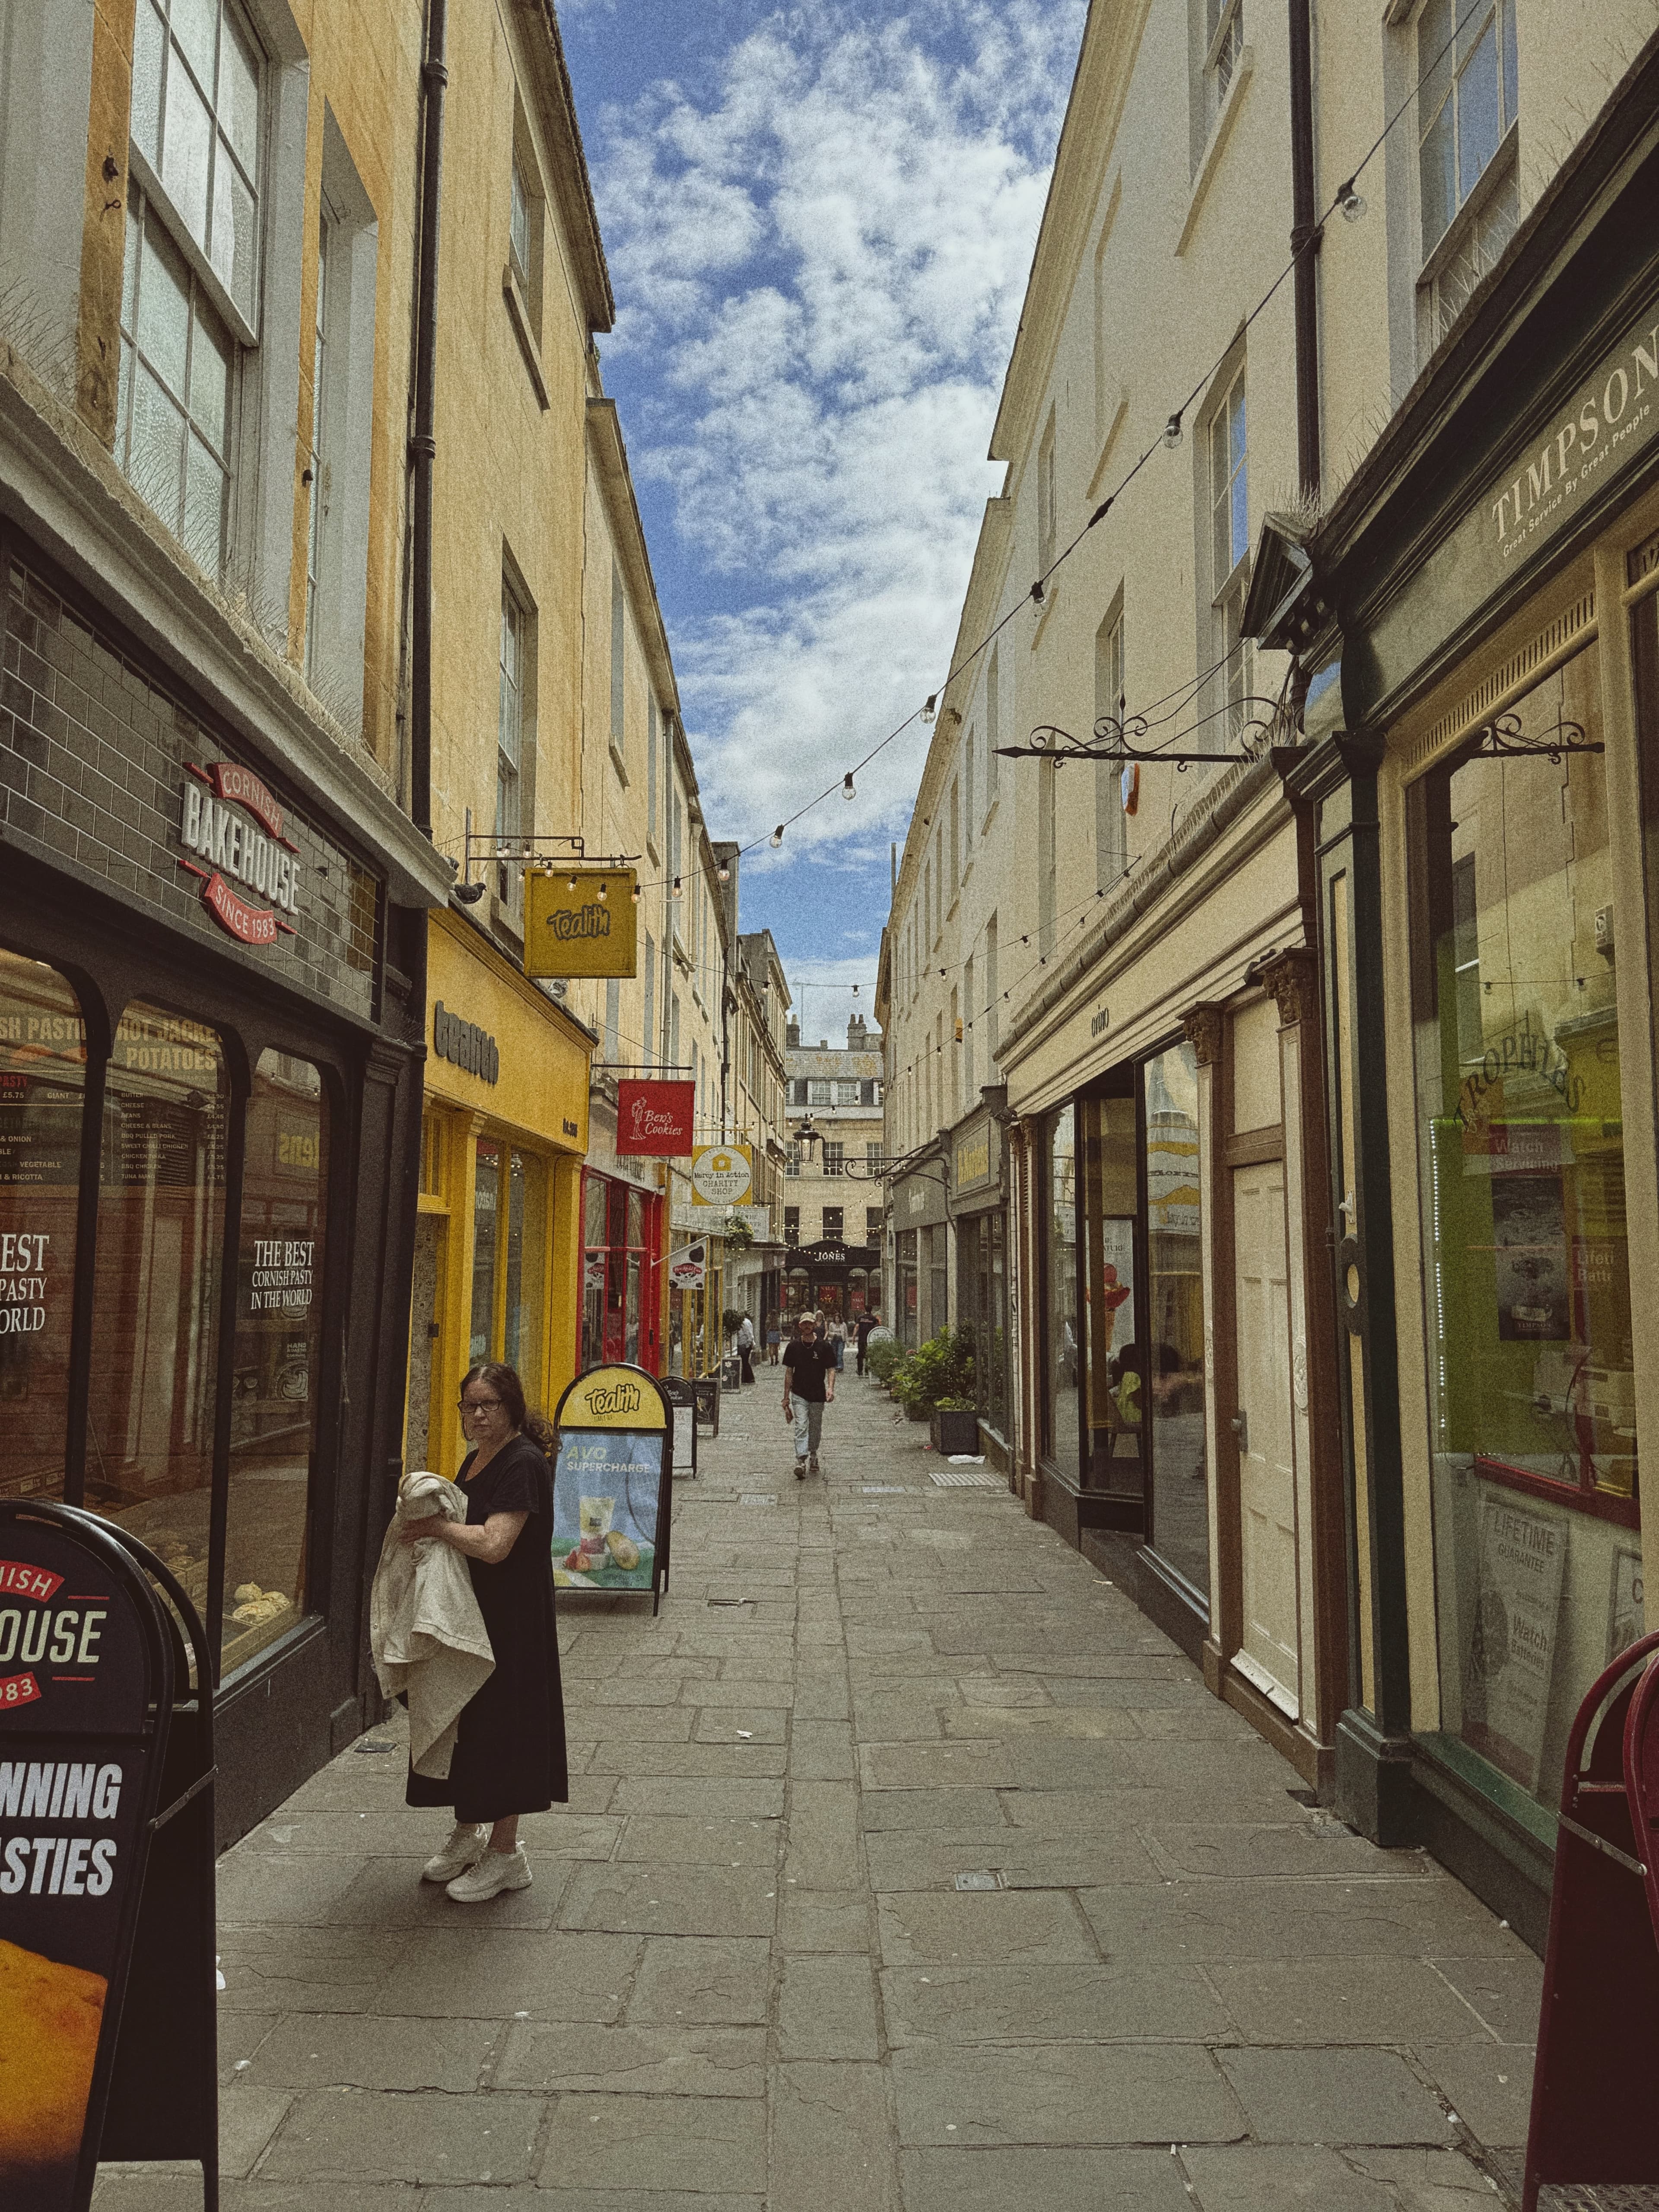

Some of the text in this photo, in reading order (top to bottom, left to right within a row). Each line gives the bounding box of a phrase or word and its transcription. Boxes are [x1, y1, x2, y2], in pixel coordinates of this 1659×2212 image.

[1492, 324, 1659, 543] TIMPSON
[1503, 404, 1649, 558] Great Service By Great People
[222, 770, 280, 830] CORNISH
[181, 782, 300, 916] BAKEHOUSE
[216, 885, 274, 939] SINCE 1983
[1091, 1004, 1109, 1038] orino
[127, 1047, 216, 1070] POTATOES
[644, 1110, 673, 1123] Ben's
[645, 1122, 683, 1135] Cookies
[0, 1234, 49, 1272] EST
[254, 1240, 315, 1267] THE BEST
[814, 1252, 845, 1262] JONES
[252, 1269, 313, 1287] CORNISH PASTY
[251, 1289, 312, 1309] IN THE WORLD
[566, 1446, 607, 1460] AVO
[566, 1462, 650, 1473] SUPERCHARGE
[1494, 1511, 1555, 1557] LIFETIME
[1498, 1543, 1545, 1574] GUARANTEE
[0, 1609, 107, 1663] OUSE
[1513, 1614, 1548, 1652] Watch
[0, 1762, 122, 1819] NNING
[0, 1837, 117, 1896] STIES
